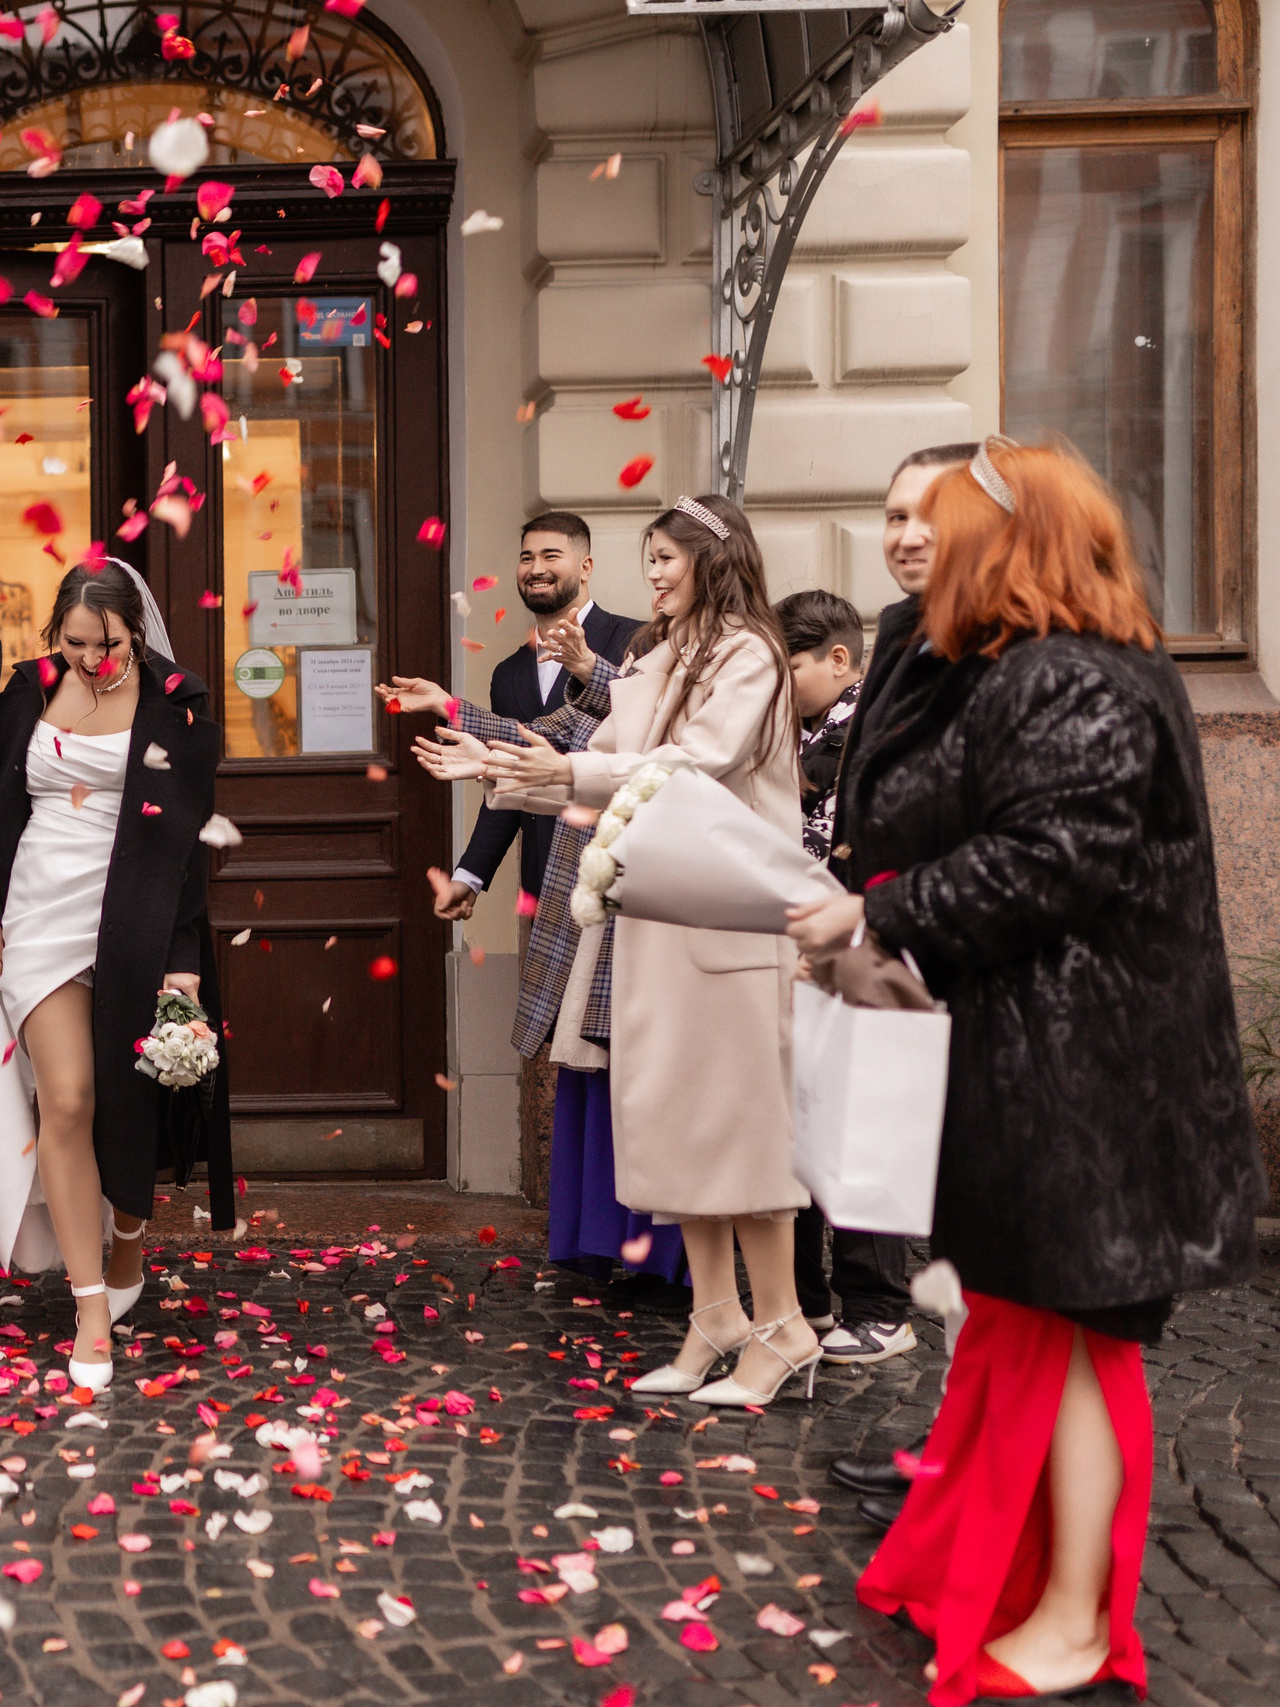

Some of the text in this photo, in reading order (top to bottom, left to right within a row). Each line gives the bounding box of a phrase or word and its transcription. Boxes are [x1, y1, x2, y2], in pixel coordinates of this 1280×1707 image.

[274, 587, 333, 598] Апотиль
[279, 606, 330, 617] во дворе
